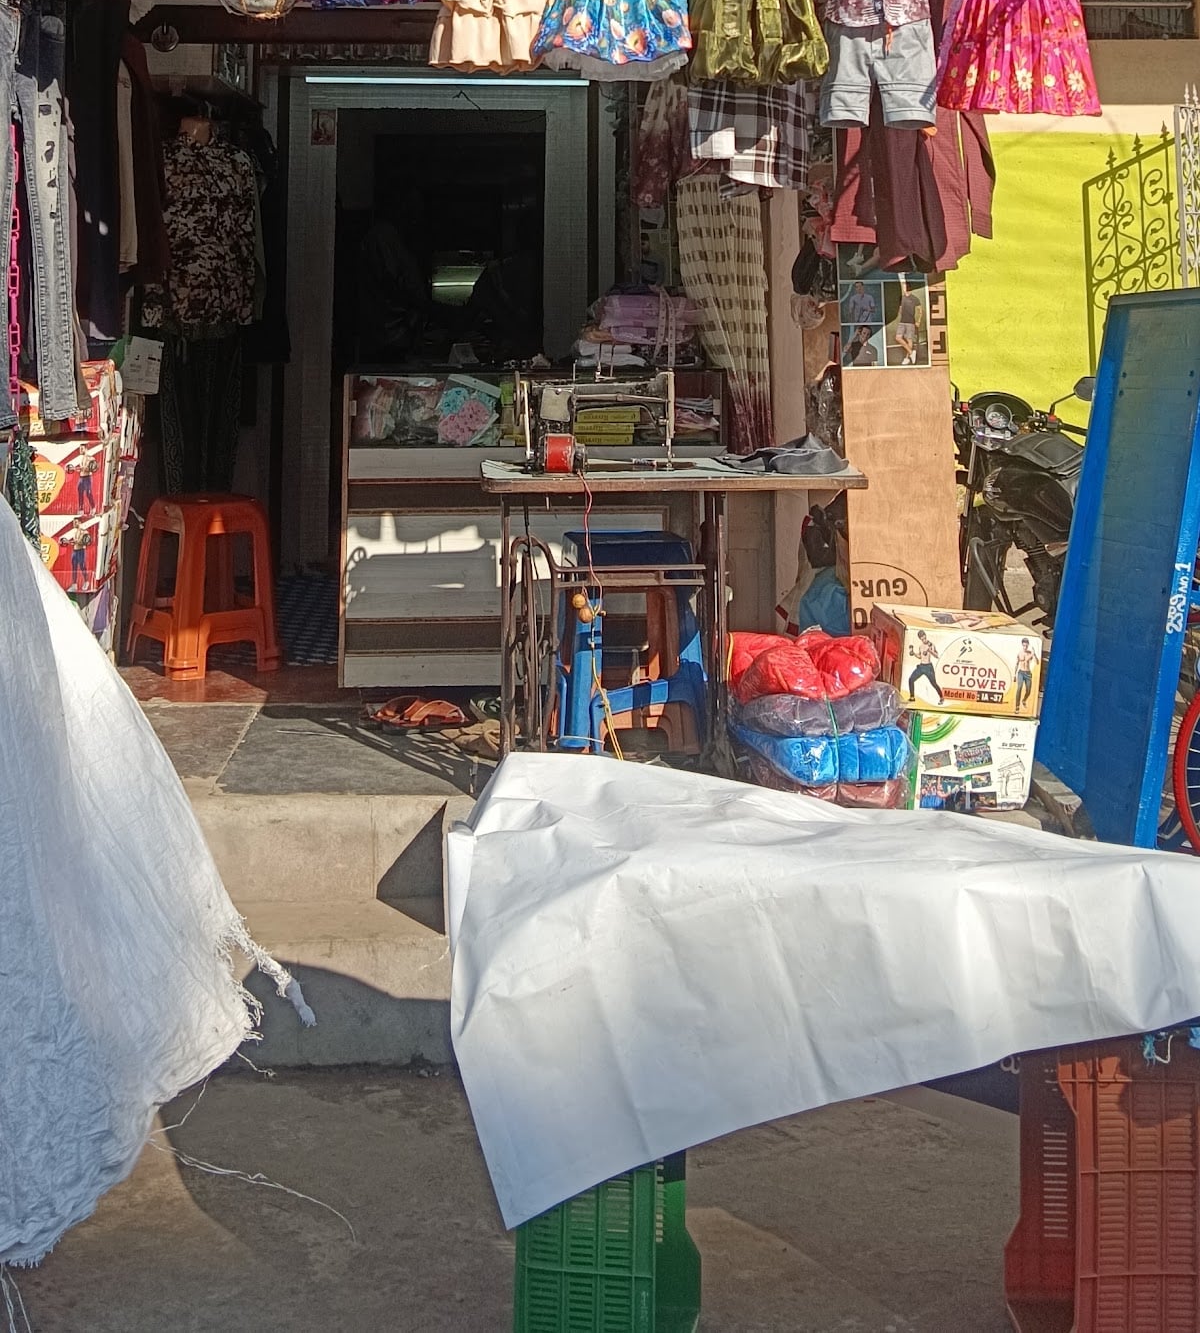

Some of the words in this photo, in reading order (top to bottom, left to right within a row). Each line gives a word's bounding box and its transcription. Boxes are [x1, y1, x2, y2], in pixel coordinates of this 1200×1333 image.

[942, 664, 997, 679] COTTON
[959, 677, 1007, 691] LOWER
[943, 690, 965, 699] Model
